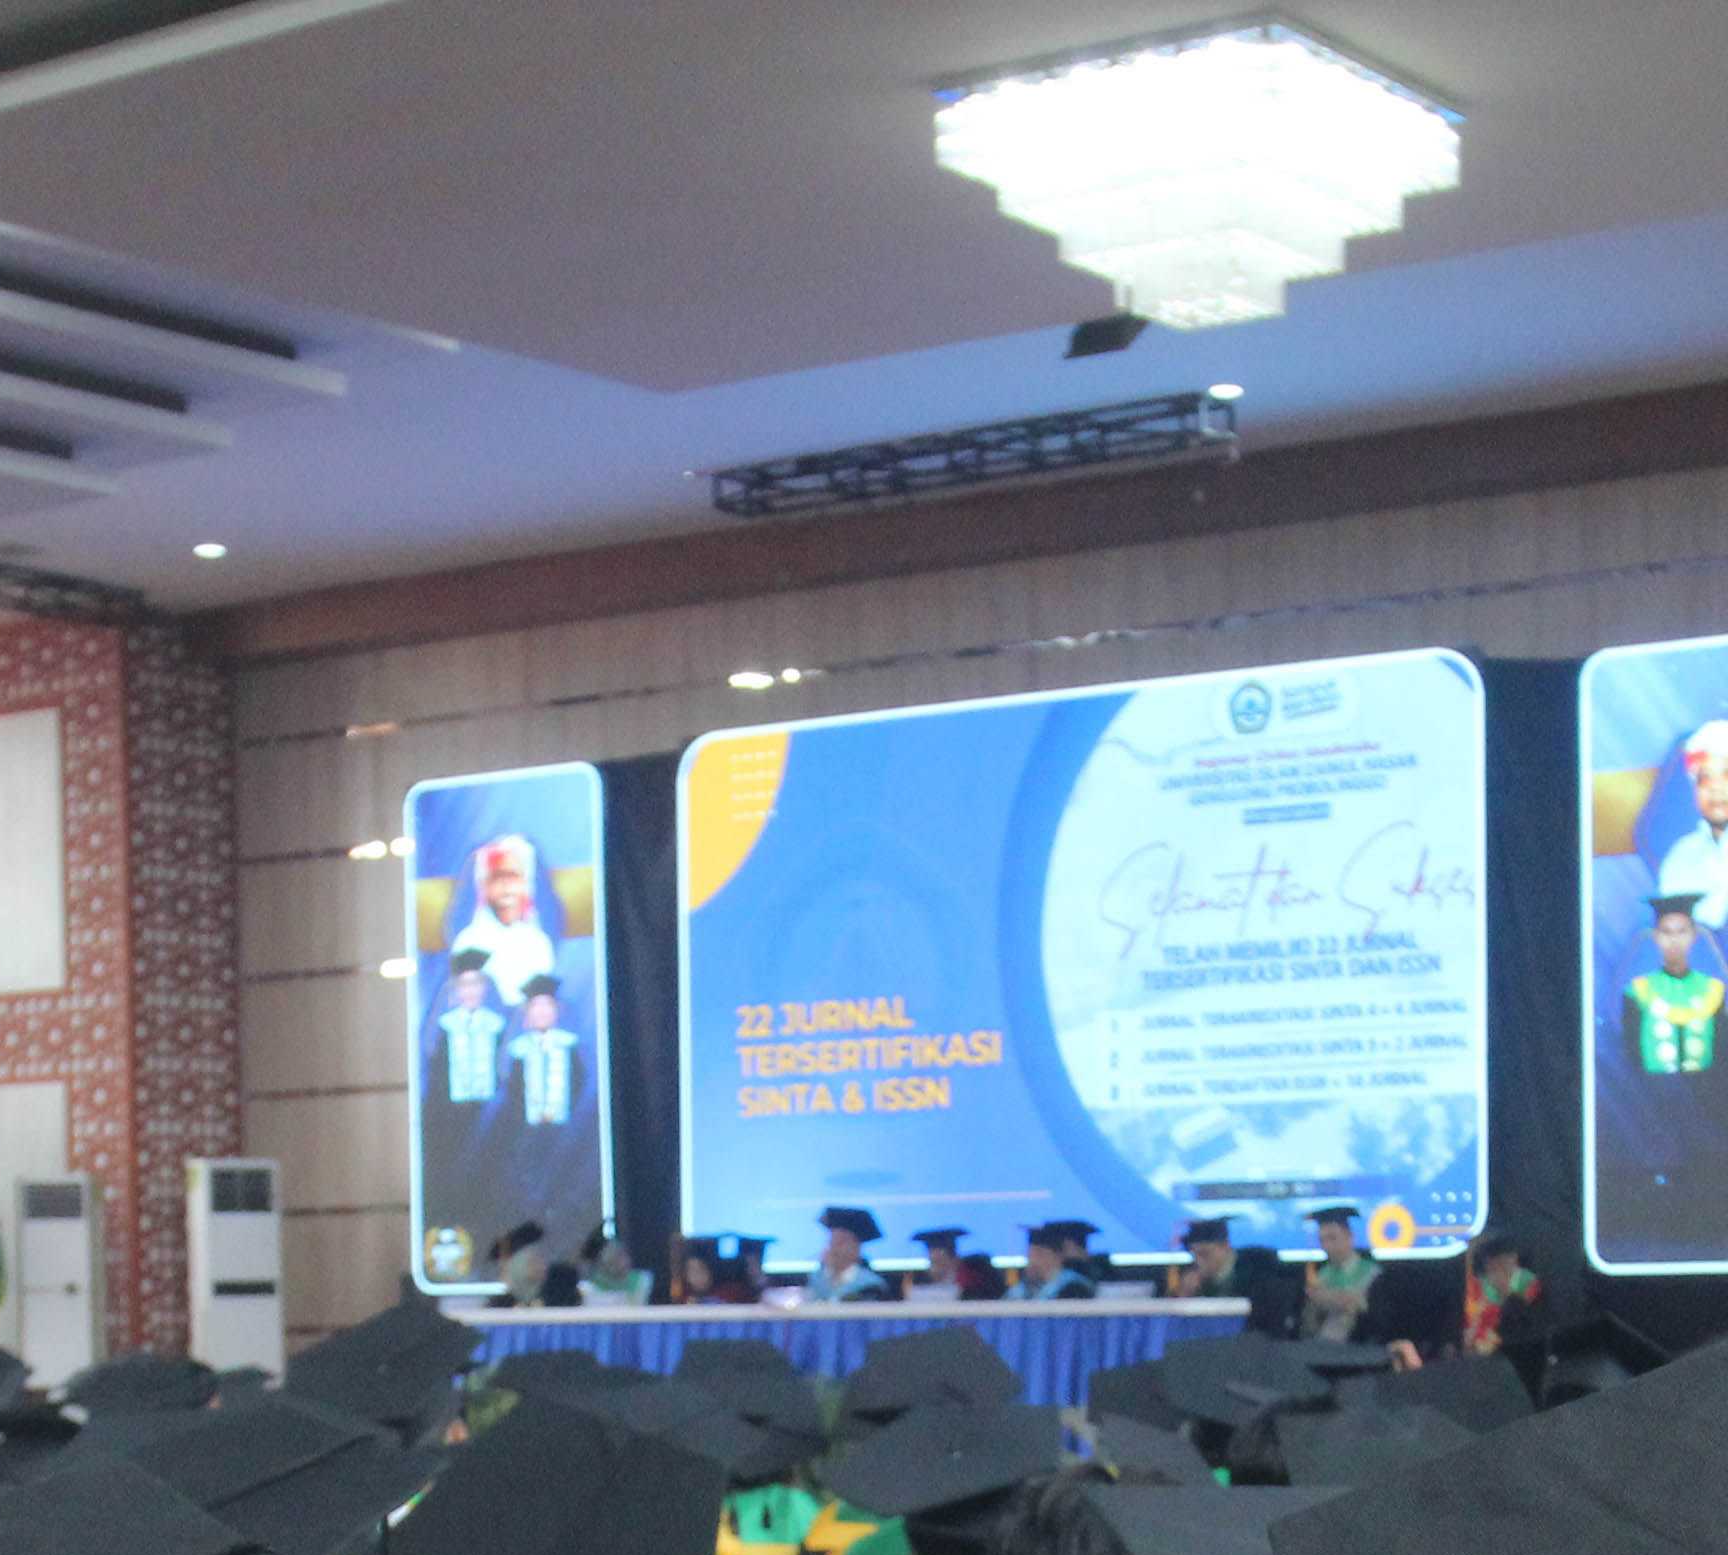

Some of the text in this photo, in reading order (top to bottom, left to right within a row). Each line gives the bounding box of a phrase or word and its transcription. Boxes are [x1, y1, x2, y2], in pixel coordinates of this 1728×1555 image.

[1162, 943, 1220, 966] TELAH
[1317, 934, 1340, 956] 22
[1345, 930, 1419, 952] JURNAL
[1140, 953, 1443, 991] TERSERTIFIKASI SINTA DAN ISSN
[735, 995, 915, 1038] 22 JURNAL
[735, 1030, 1004, 1077] TERSERTIFIKASI
[738, 1076, 951, 1118] SINTA & ISSN
